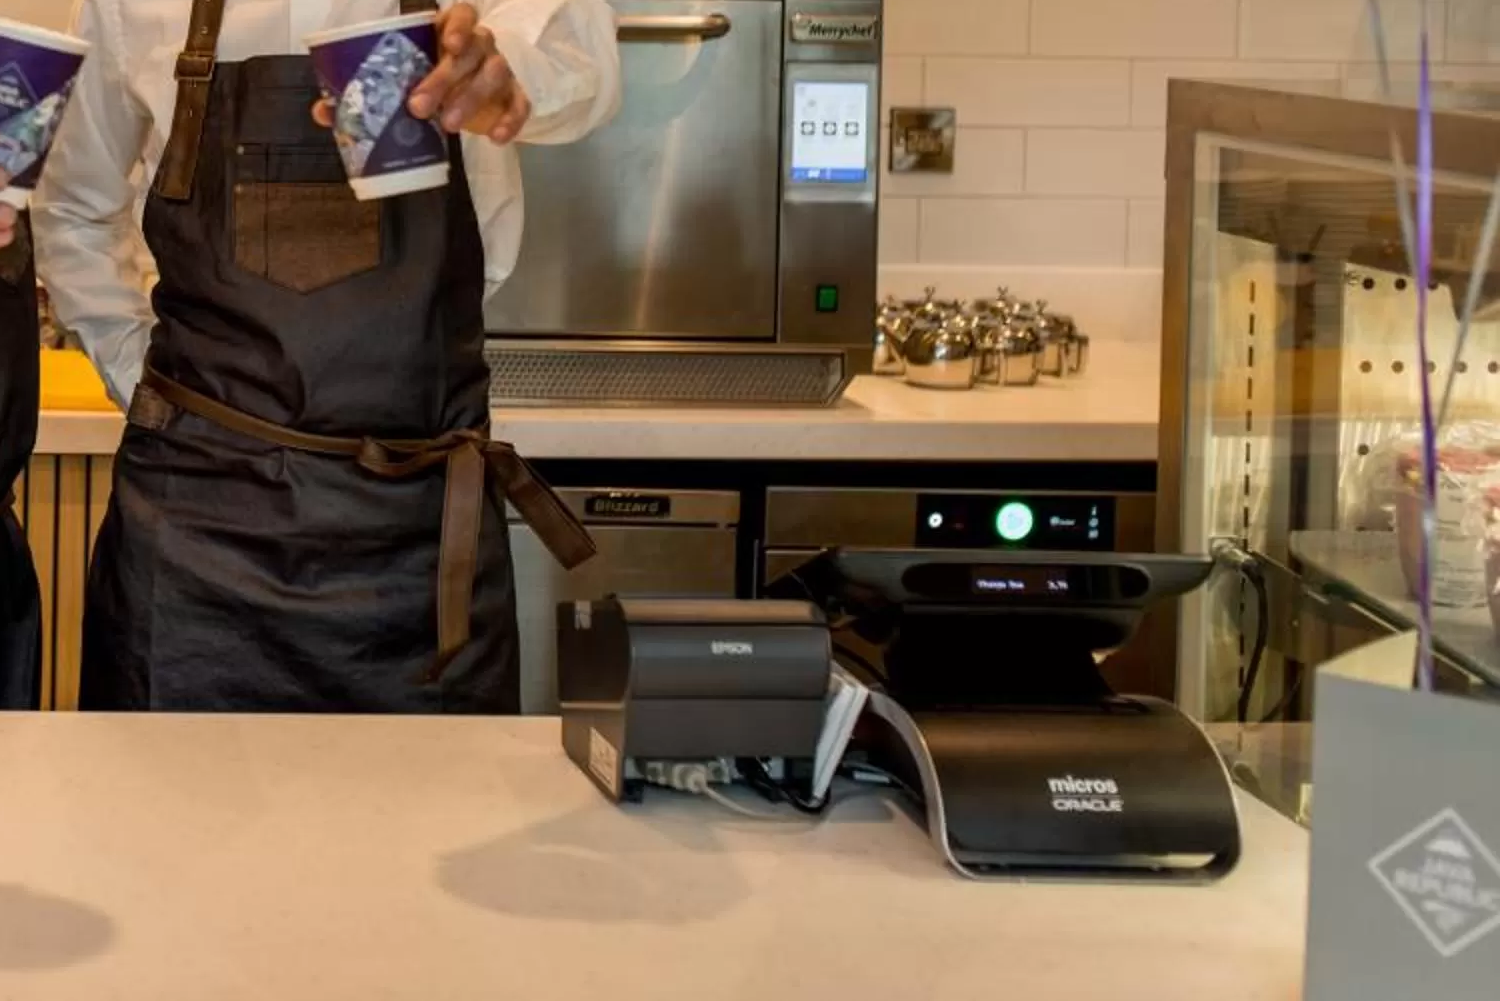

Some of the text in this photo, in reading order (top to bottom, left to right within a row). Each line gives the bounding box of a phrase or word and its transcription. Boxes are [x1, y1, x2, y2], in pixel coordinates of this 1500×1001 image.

[808, 22, 873, 40] Merrychef
[710, 640, 754, 656] EPSON
[1047, 774, 1119, 794] micros
[1051, 798, 1124, 812] ORACLE
